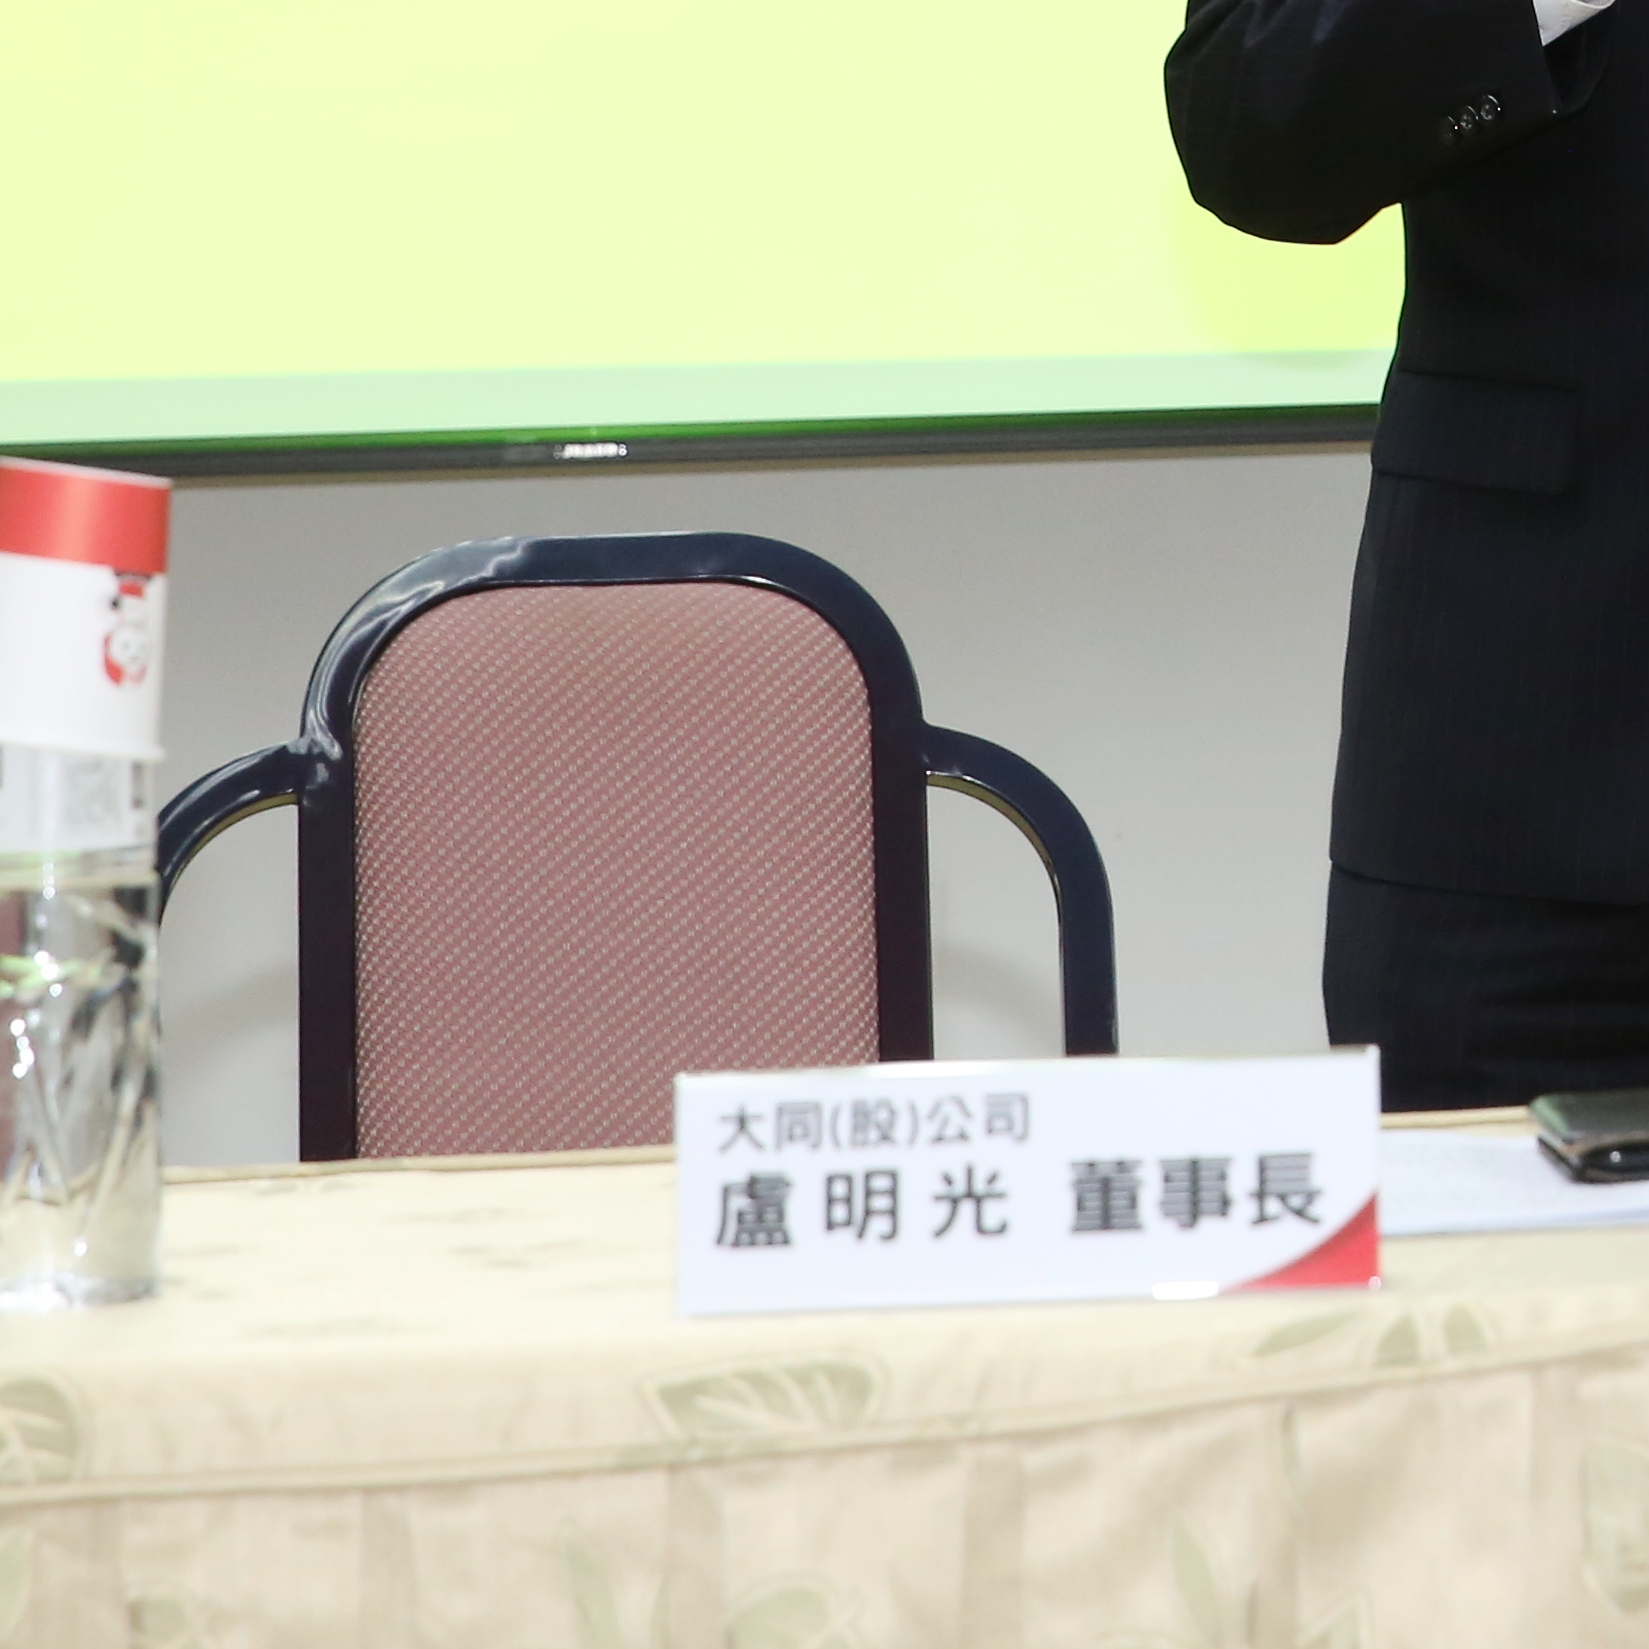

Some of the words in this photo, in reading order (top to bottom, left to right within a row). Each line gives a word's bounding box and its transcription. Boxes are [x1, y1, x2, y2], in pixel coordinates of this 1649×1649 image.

[720, 1094, 1029, 1152] 大同(股)公司
[715, 1164, 1010, 1247] 盧明光
[1070, 1152, 1322, 1233] 董事長
